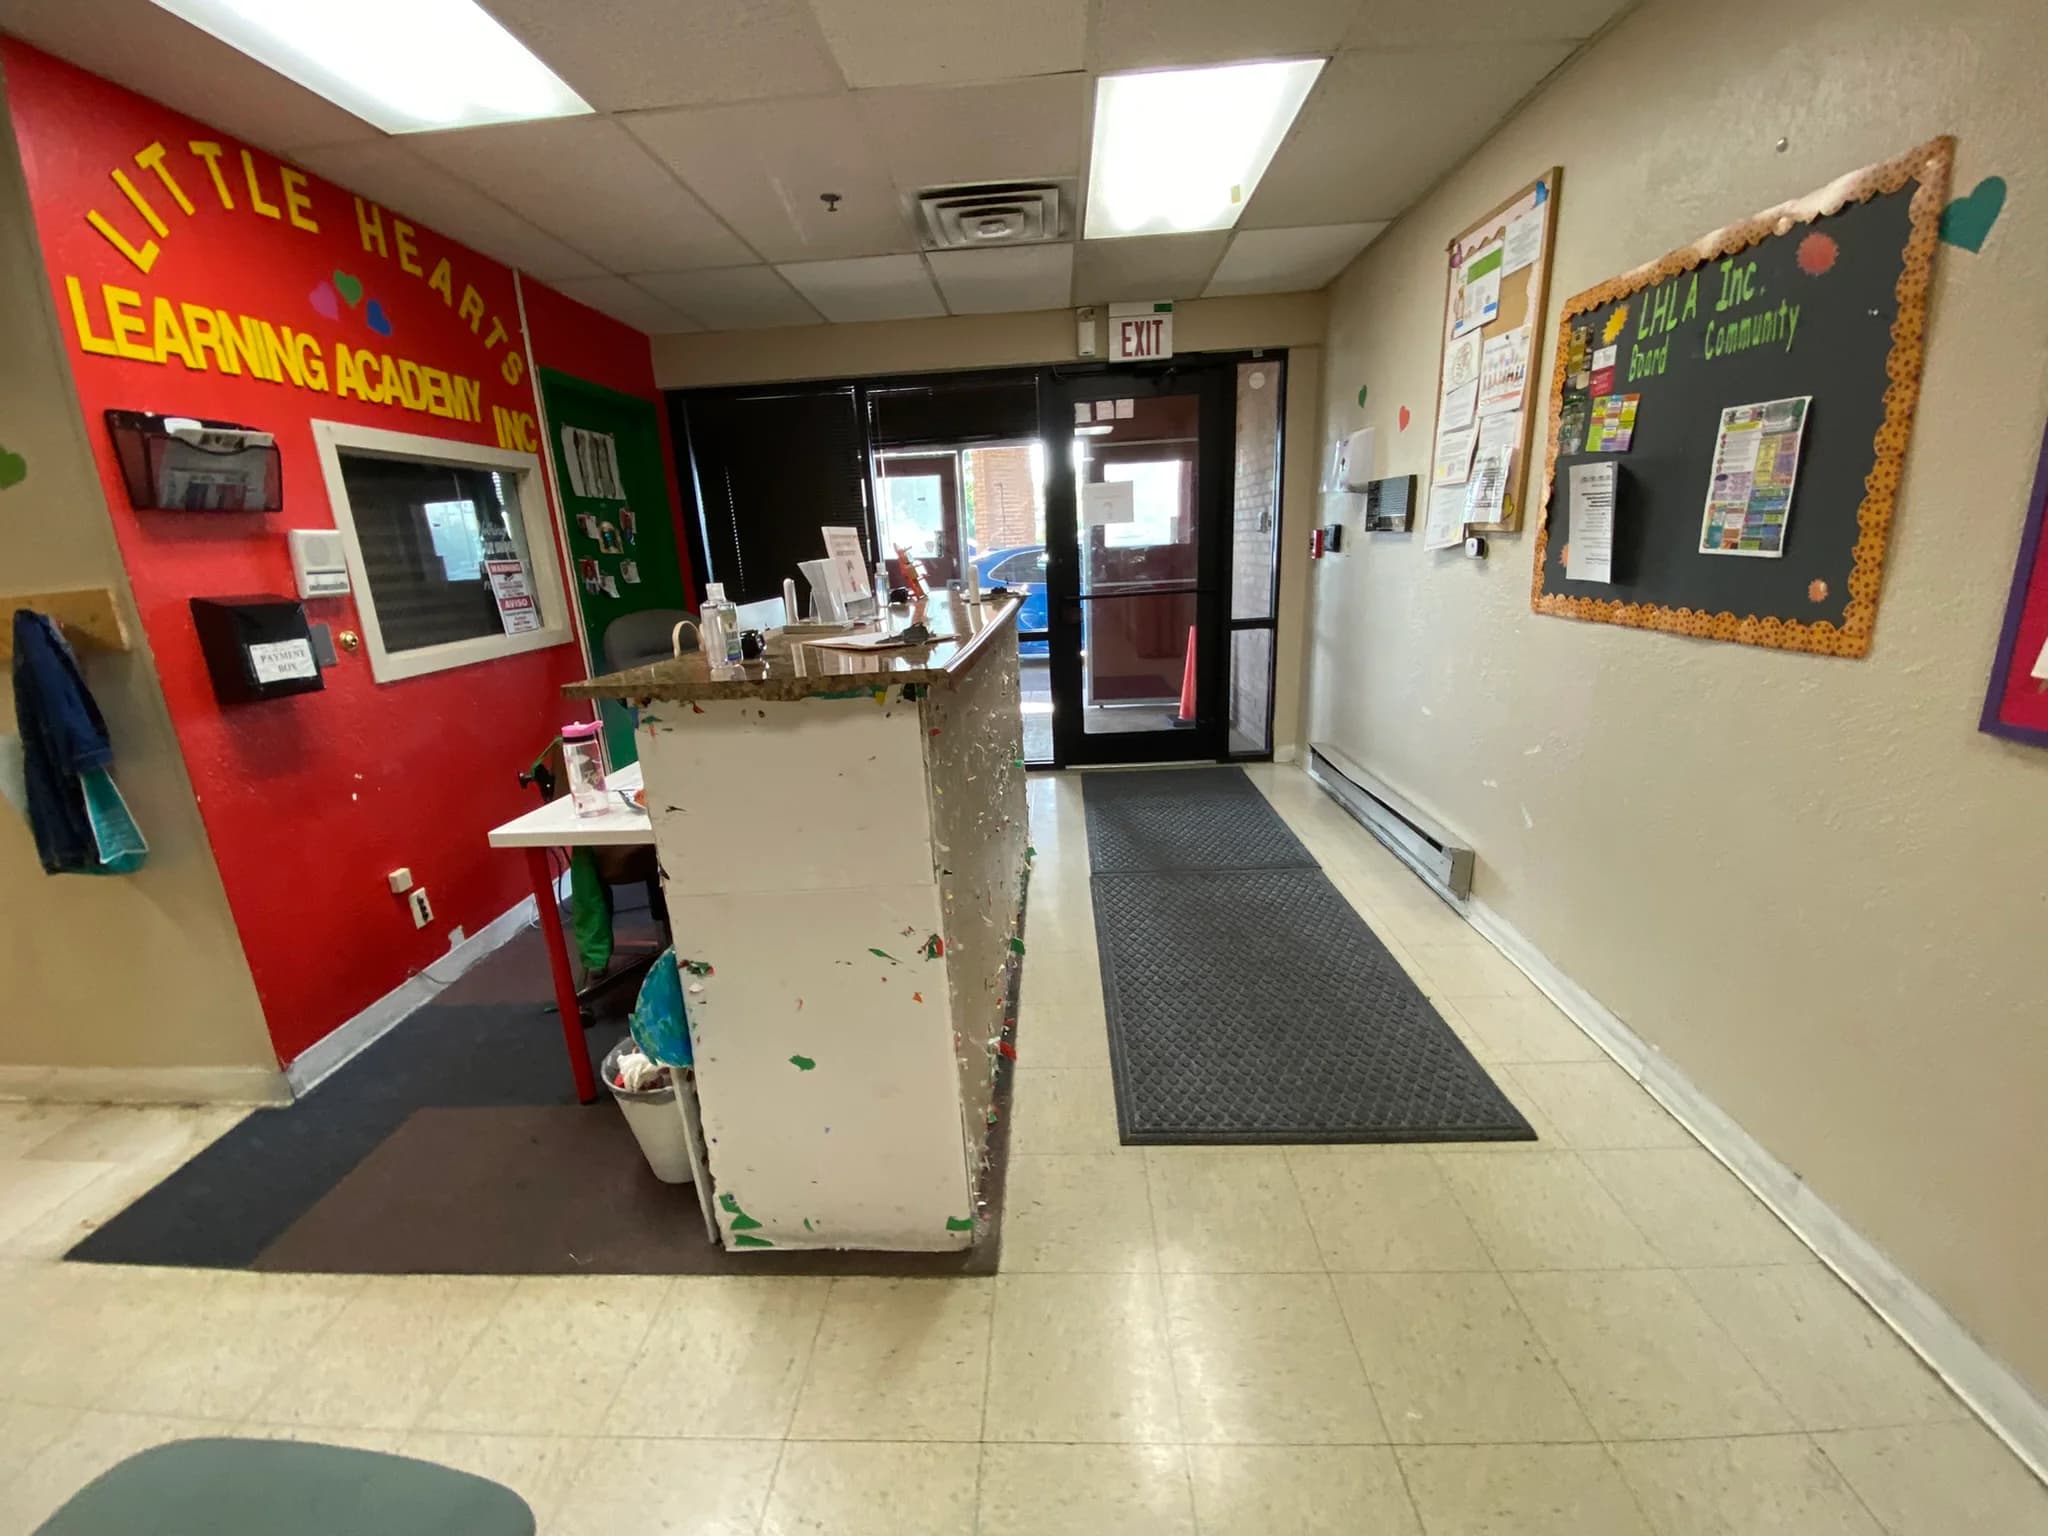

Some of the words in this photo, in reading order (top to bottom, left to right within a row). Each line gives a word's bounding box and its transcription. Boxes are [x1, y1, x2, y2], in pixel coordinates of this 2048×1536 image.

[85, 141, 320, 275] LITTLE
[354, 196, 524, 387] HEARTS
[1715, 257, 1766, 312] Inc.
[1120, 319, 1164, 358] EXIT
[1628, 333, 1671, 383] Board
[1705, 299, 1799, 360] Community
[65, 274, 330, 392] LEARNING
[335, 342, 481, 423] ACADEMY
[492, 405, 538, 453] INC
[504, 599, 528, 609] AVISO
[261, 650, 305, 663] PAYMENT
[278, 663, 298, 673] BOX
